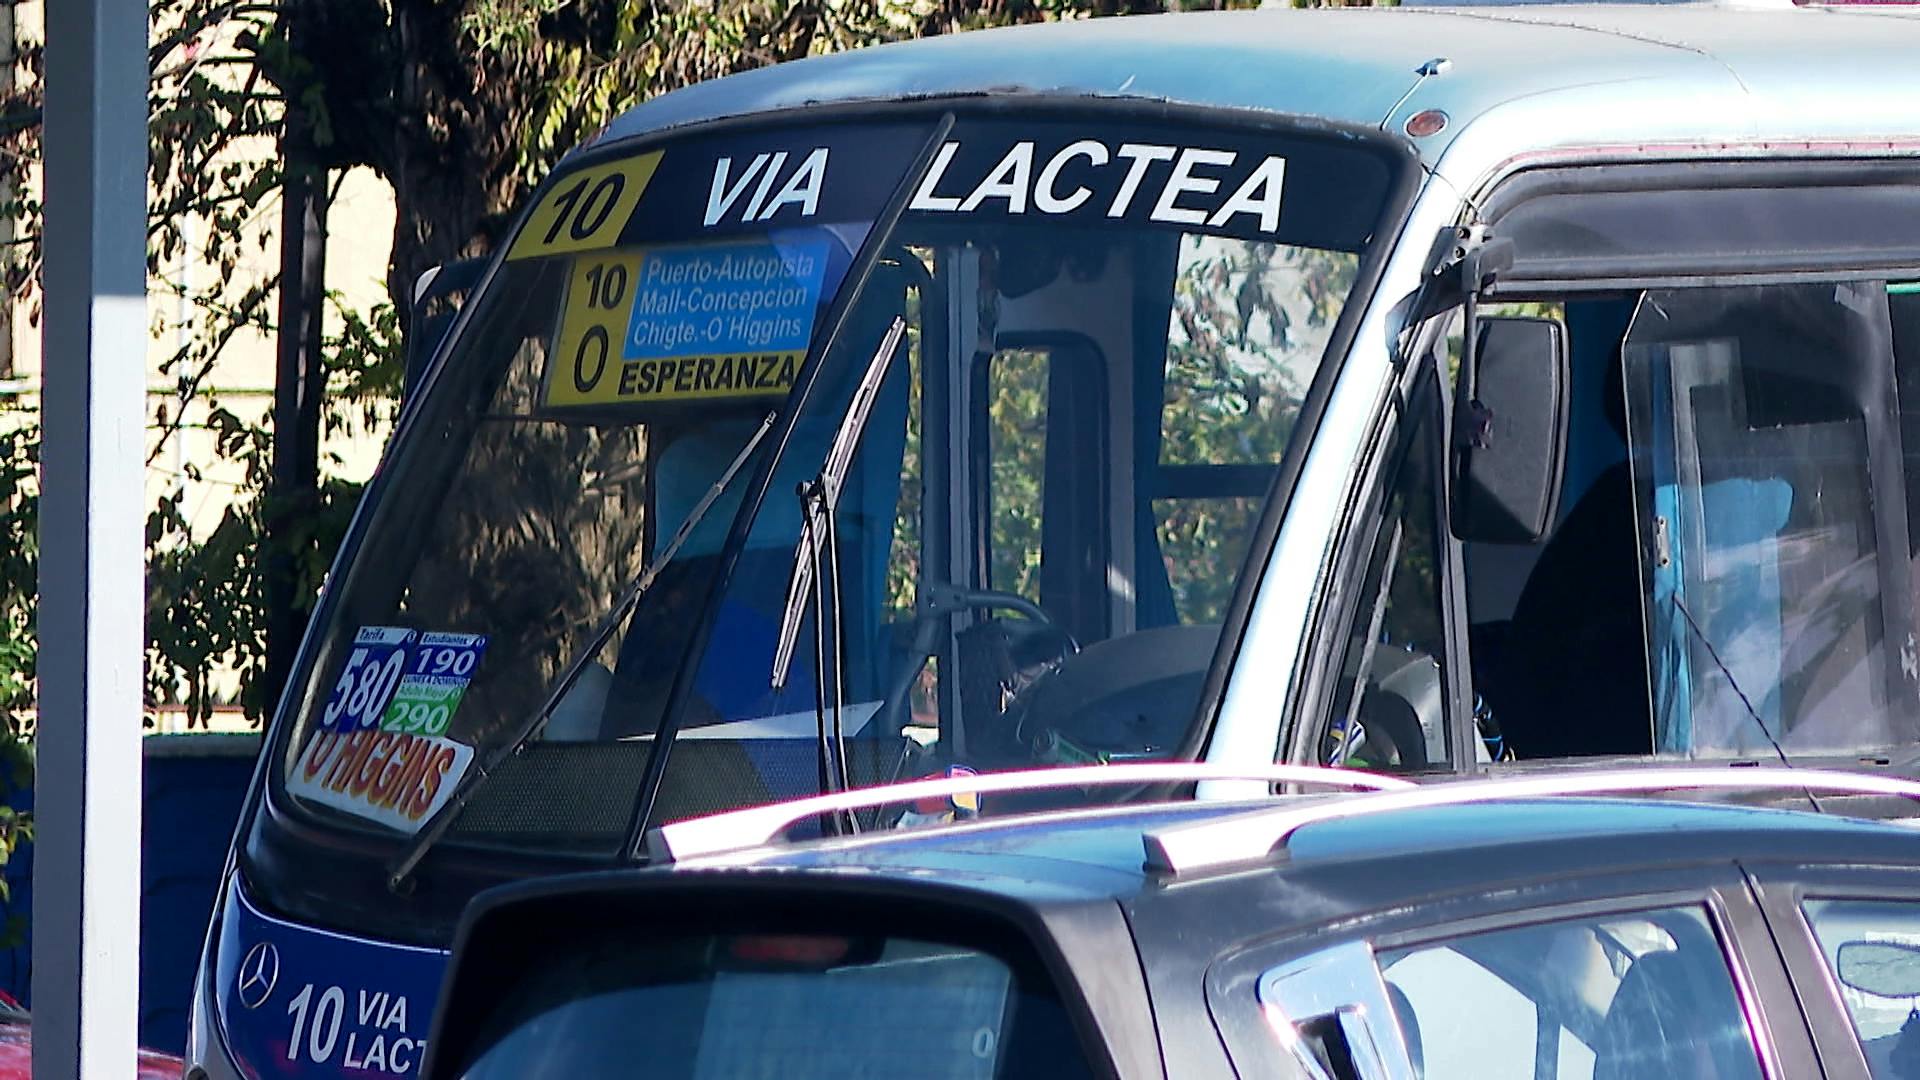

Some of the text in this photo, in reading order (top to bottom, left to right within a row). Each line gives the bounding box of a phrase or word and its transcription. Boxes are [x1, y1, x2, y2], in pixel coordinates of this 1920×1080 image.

[543, 173, 626, 245] 10
[704, 140, 1287, 233] VIA LACTEA
[585, 263, 628, 310] 10
[618, 355, 796, 396] ESPERANZA
[359, 628, 385, 641] Tarifa
[416, 648, 476, 676] 190
[323, 648, 406, 728] 580
[383, 702, 450, 734] 290
[287, 983, 345, 1064] 10
[358, 989, 407, 1033] VIA
